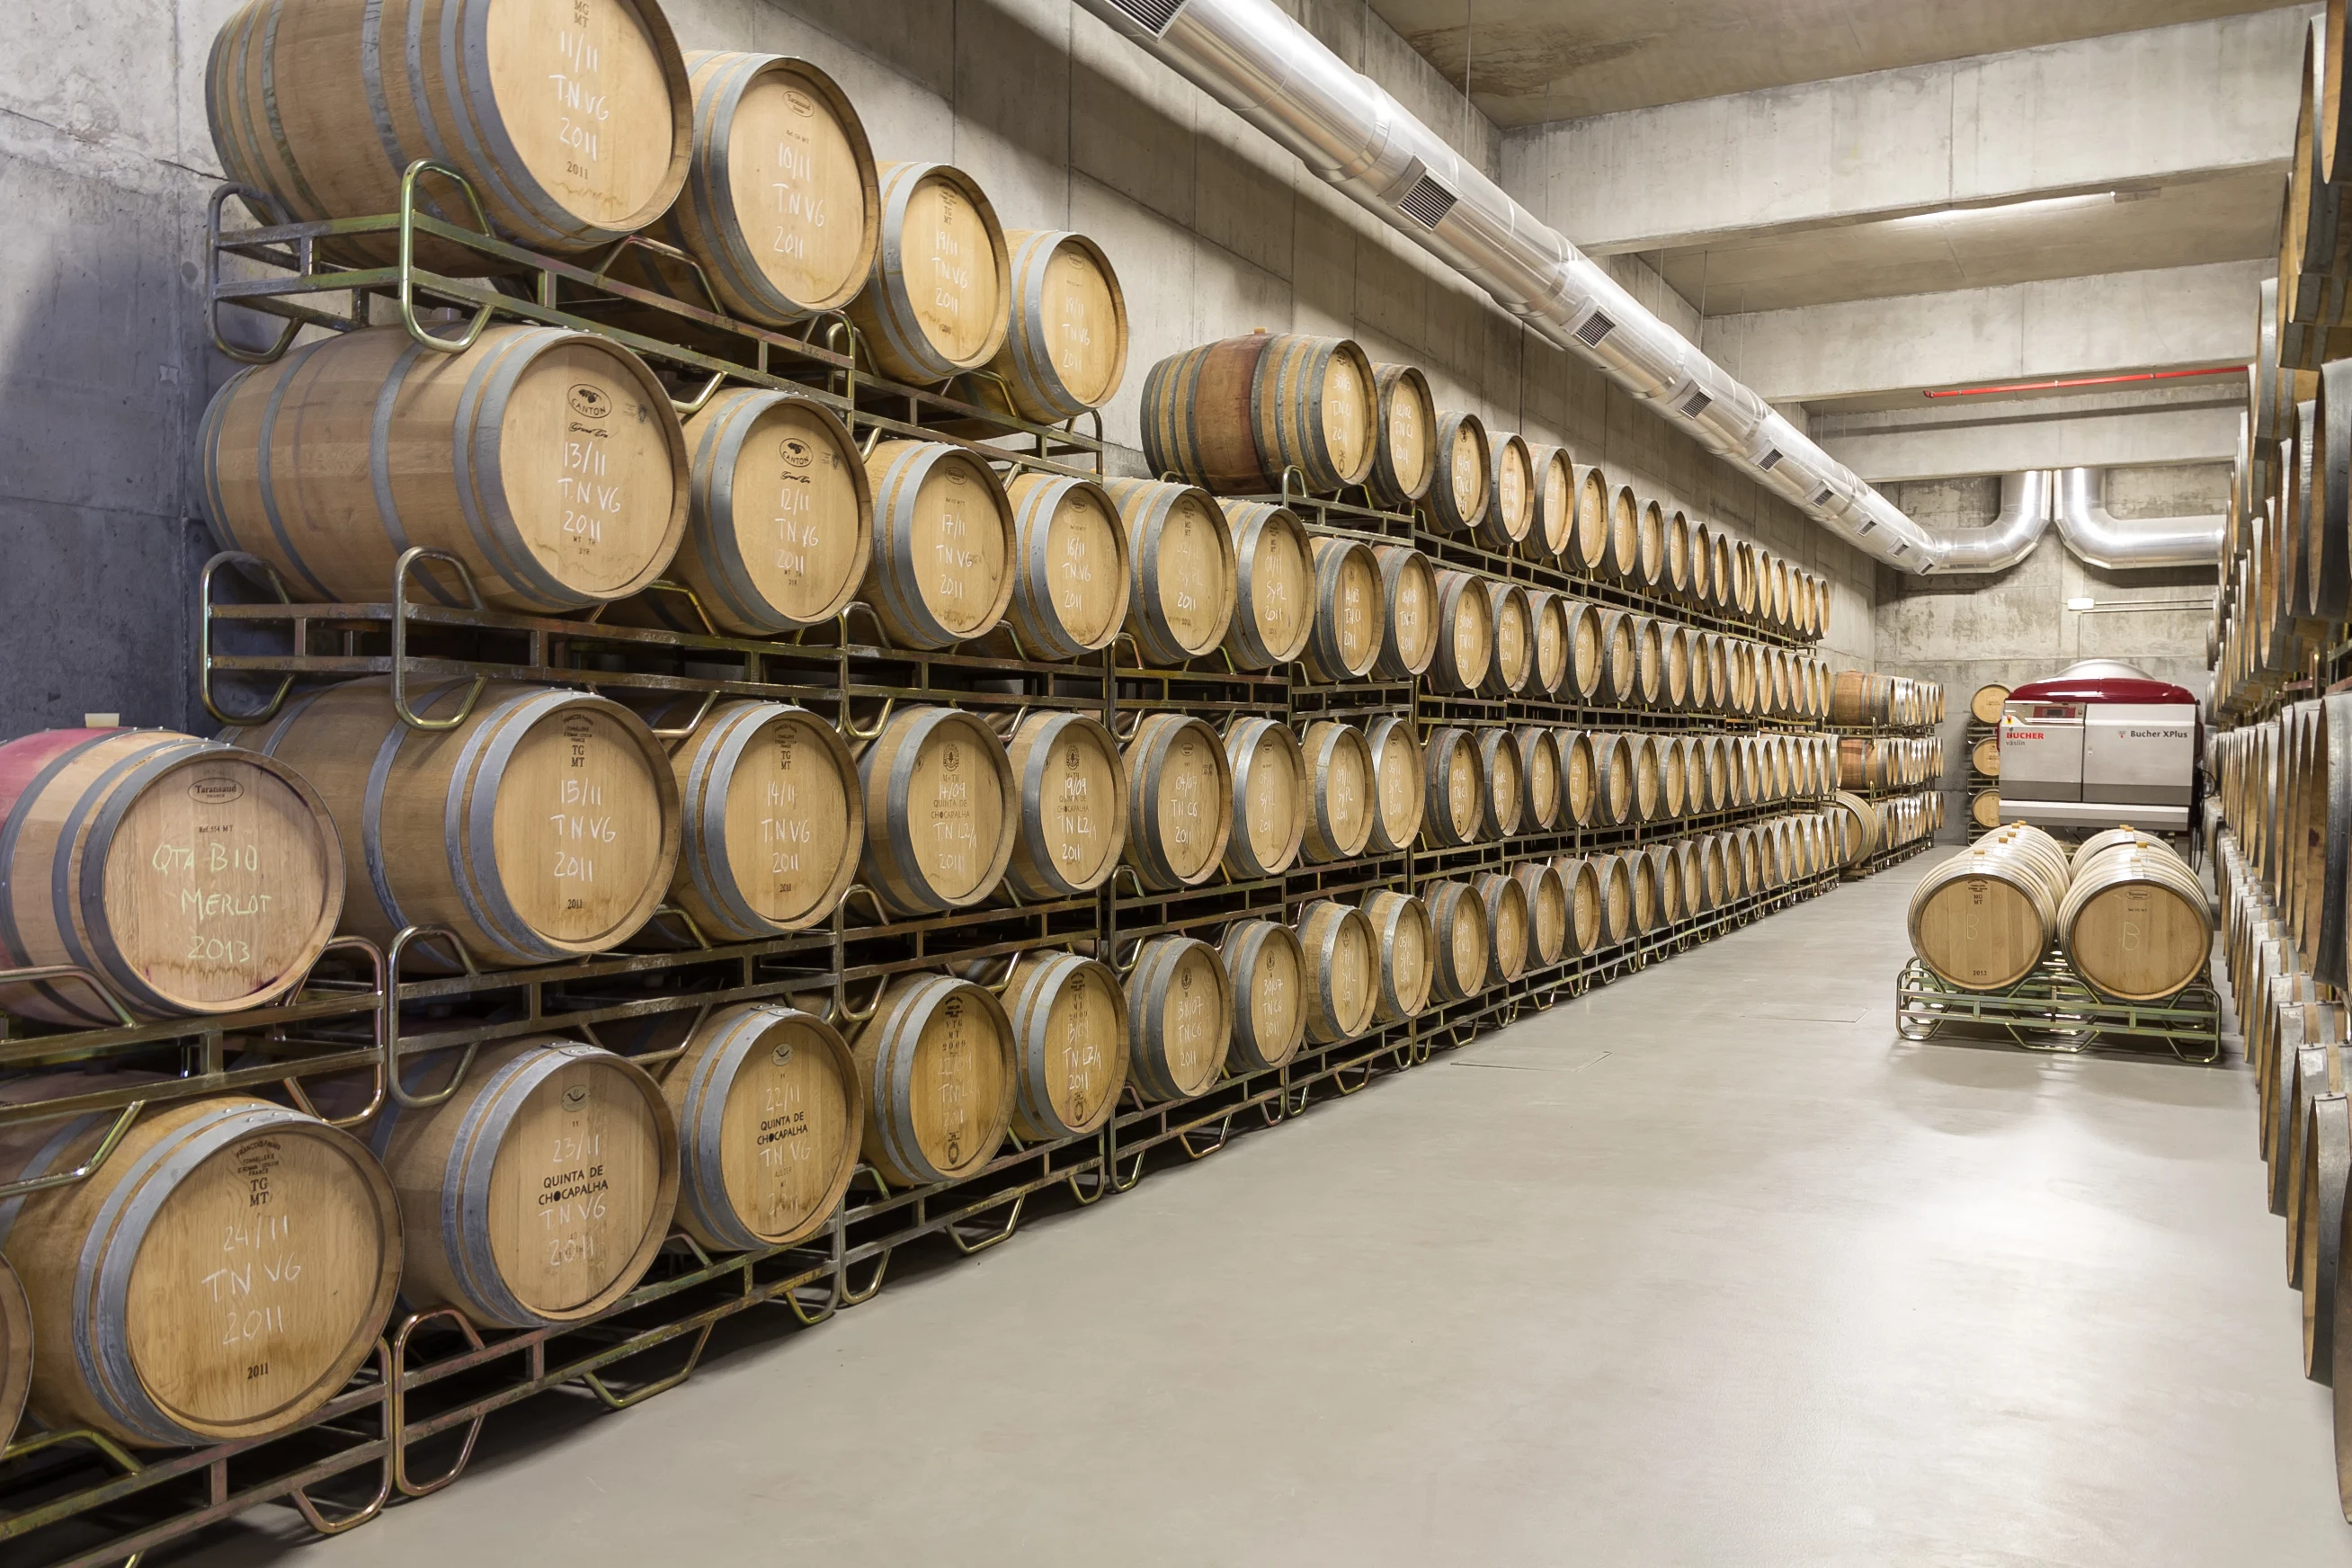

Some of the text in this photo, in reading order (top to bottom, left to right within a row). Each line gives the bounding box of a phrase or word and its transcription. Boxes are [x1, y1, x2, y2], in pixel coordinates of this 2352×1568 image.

[574, 13, 589, 29] MT
[561, 31, 598, 73] 11/11
[559, 117, 597, 163] 2011
[566, 160, 590, 181] 2011
[779, 142, 811, 183] 10/11
[773, 226, 804, 260] 2011
[935, 230, 958, 256] 19/11
[935, 287, 959, 316] 2011
[1063, 348, 1082, 372] 2011
[571, 397, 606, 416] CANTON
[1332, 425, 1348, 447] 2011
[564, 441, 607, 477] 13/11
[782, 450, 810, 465] CANTON
[780, 487, 810, 516] 12/11
[563, 510, 601, 544] 2011
[942, 512, 966, 539] 17/11
[1066, 536, 1086, 561] 16/11
[776, 548, 805, 575] 2011
[940, 574, 963, 600] 2011
[1065, 589, 1082, 612] 2011
[1177, 592, 1197, 612] 2011
[1264, 606, 1283, 622] 2011
[1344, 630, 1356, 649] 2011
[1400, 637, 1413, 652] 2011
[2006, 732, 2045, 740] BUCHER
[2129, 729, 2189, 738] Bucher XPlus
[572, 744, 585, 756] TG
[780, 750, 791, 761] TG
[571, 756, 585, 768] MT
[780, 761, 791, 771] MT
[195, 784, 236, 794] Taransaud
[560, 777, 601, 806] 15/11
[766, 780, 795, 807] 14/11
[939, 780, 966, 800] 14/09
[1065, 777, 1087, 800] 19/09
[933, 798, 967, 807] QUINTA DE
[1057, 804, 1090, 813] CHOCAPALHA
[1389, 801, 1401, 815] 2011
[1454, 802, 1465, 814] 2011
[931, 810, 971, 819] CHOCAPALHA
[1336, 807, 1348, 821] 2011
[1175, 825, 1191, 845] 2011
[1259, 819, 1274, 833] 2011
[152, 842, 195, 877] QTA
[772, 851, 799, 874] 2011
[1062, 843, 1081, 861] 2011
[554, 851, 592, 883] 2011
[181, 886, 272, 922] MERLOT
[567, 899, 583, 910] 2011
[1966, 913, 1980, 940] B
[2122, 921, 2141, 952] B
[187, 934, 251, 964] 2013
[1265, 1020, 1280, 1038] 2011
[942, 1040, 967, 1052] 2009
[1179, 1049, 1197, 1067] 2011
[1068, 1071, 1089, 1091] 2011
[766, 1083, 800, 1112] 22/11
[760, 1110, 805, 1132] QUINTA DE
[756, 1123, 809, 1146] CHOCAPALHA
[552, 1129, 600, 1163] 23/11
[250, 1177, 269, 1192] TG
[543, 1163, 604, 1189] QUINTA DE
[249, 1191, 270, 1207] MT
[538, 1179, 610, 1207] CHOCAPALHA
[223, 1215, 289, 1252] 24/11
[549, 1234, 594, 1267] 2011
[223, 1305, 284, 1347] 2011
[246, 1362, 270, 1381] 2011
